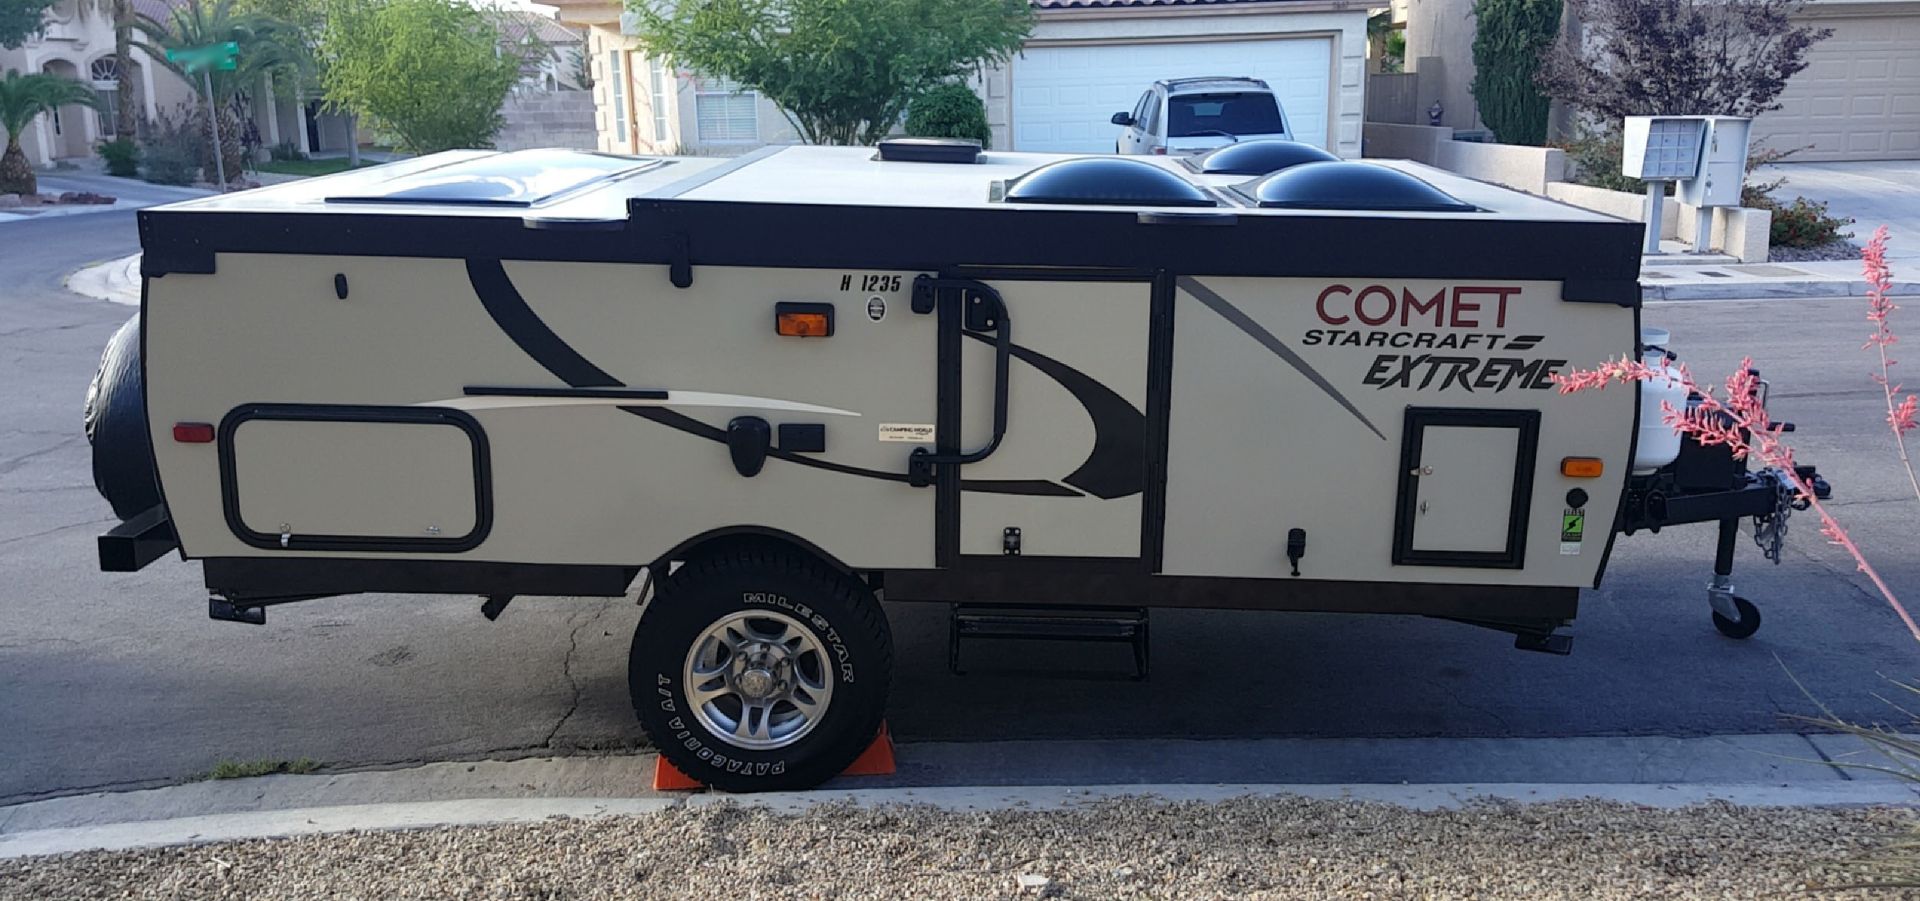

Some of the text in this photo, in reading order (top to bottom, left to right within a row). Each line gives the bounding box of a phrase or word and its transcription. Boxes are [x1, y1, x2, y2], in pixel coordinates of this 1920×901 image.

[840, 274, 902, 292] H 1235
[1316, 284, 1522, 328] COMET
[1302, 329, 1505, 350] STARCRAFT
[1362, 354, 1567, 393] EXTREME
[743, 593, 854, 683] MILESTAR
[668, 716, 785, 776] PATAGONIA
